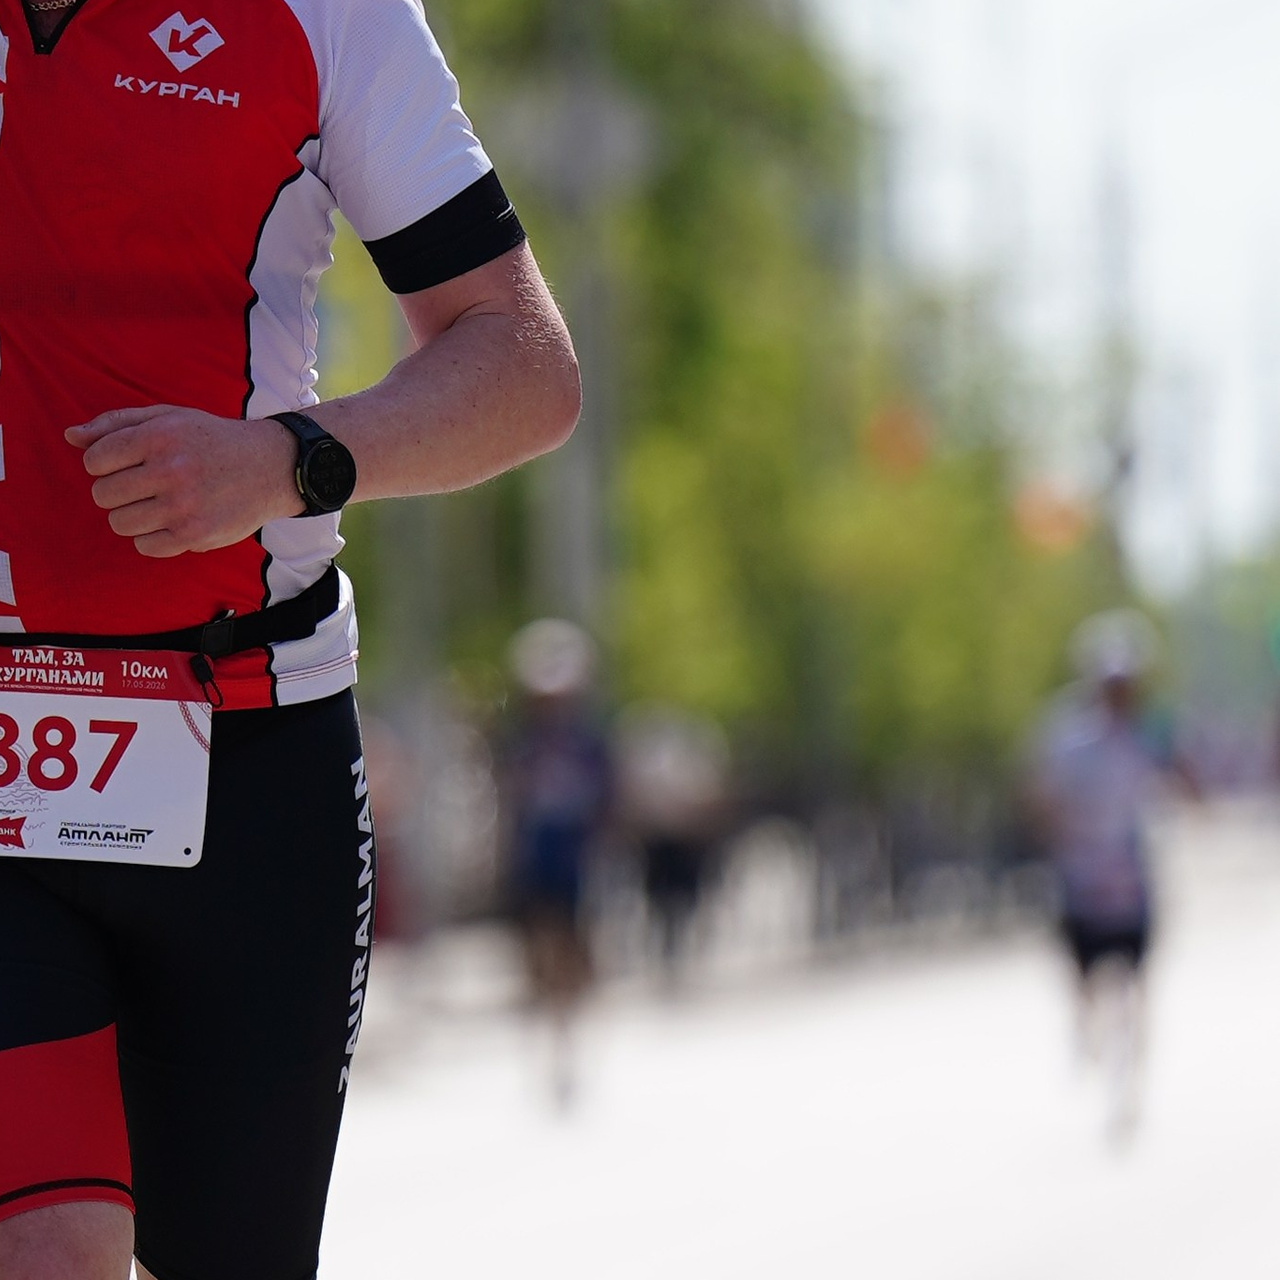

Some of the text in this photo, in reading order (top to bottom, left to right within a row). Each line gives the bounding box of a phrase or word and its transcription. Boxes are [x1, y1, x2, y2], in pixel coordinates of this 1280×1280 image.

[114, 73, 240, 109] КУРГАН
[12, 648, 85, 667] ТАМ, ЗА
